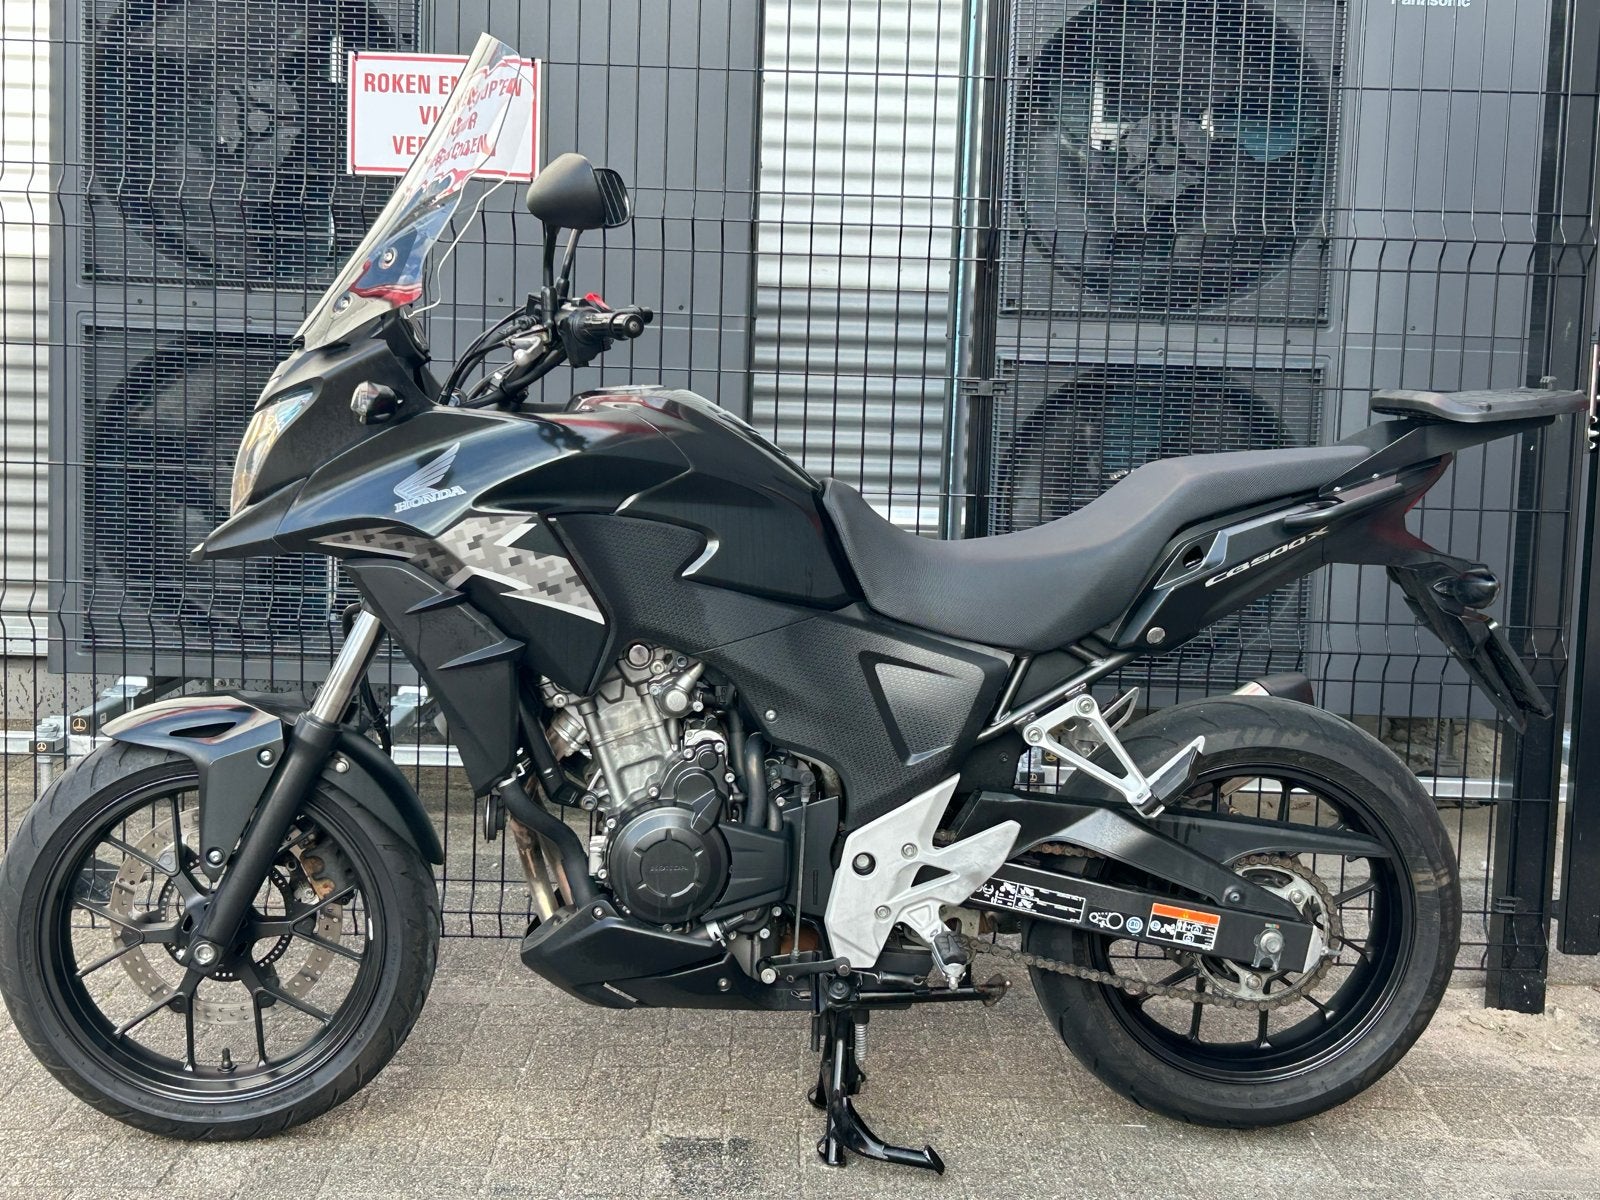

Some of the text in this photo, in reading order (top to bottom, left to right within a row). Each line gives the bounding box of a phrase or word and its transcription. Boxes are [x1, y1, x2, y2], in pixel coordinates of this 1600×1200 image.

[364, 73, 431, 94] ROKEN
[394, 485, 467, 513] HONDA
[1204, 526, 1329, 588] CB500X
